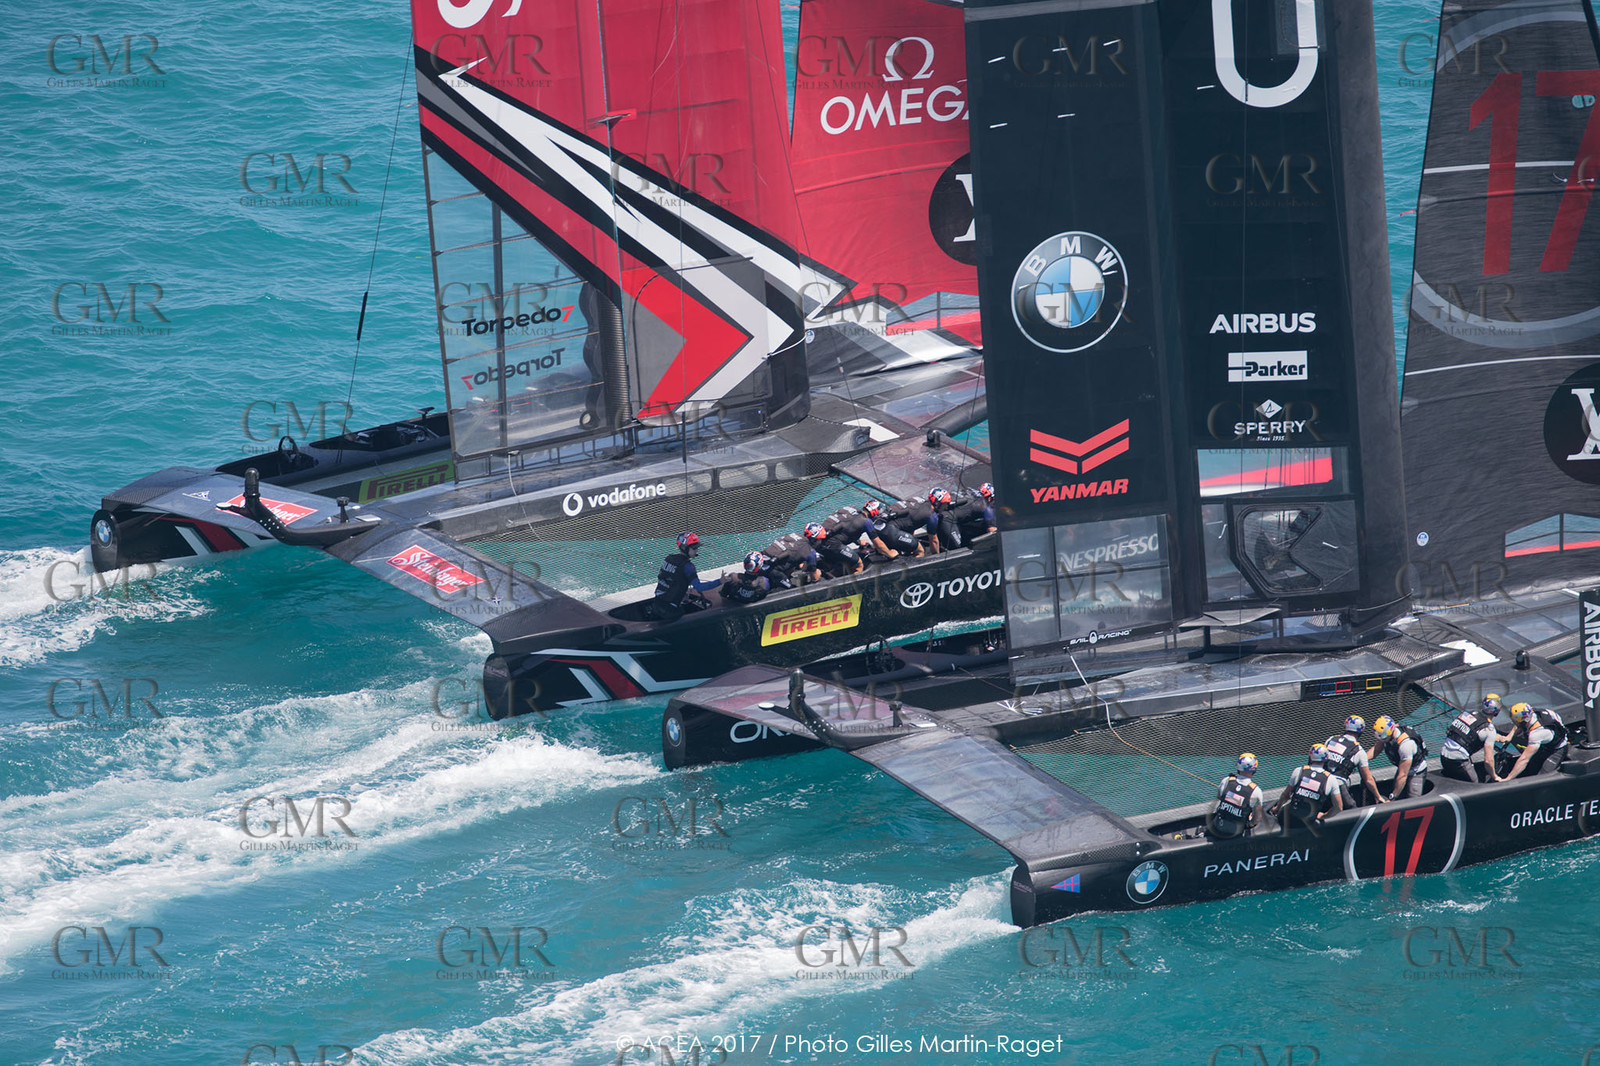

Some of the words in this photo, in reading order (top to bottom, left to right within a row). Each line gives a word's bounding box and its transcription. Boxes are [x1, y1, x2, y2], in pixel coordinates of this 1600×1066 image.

[821, 86, 968, 134] OMEG
[1024, 235, 1118, 277] BMW
[462, 305, 575, 336] Torpedo7
[1209, 312, 1317, 334] AIRBUS
[1244, 360, 1306, 377] Parker
[1234, 420, 1306, 435] SPERRY
[367, 464, 449, 500] PIRELLI
[587, 483, 666, 508] vodafone
[1030, 478, 1129, 503] YANMAR
[1059, 533, 1159, 571] NESPRESSO
[770, 602, 852, 638] PIRELLI
[1510, 805, 1574, 829] ORACLE
[1580, 799, 1600, 817] TE
[1381, 806, 1435, 877] 17
[1204, 848, 1310, 878] PANERAI
